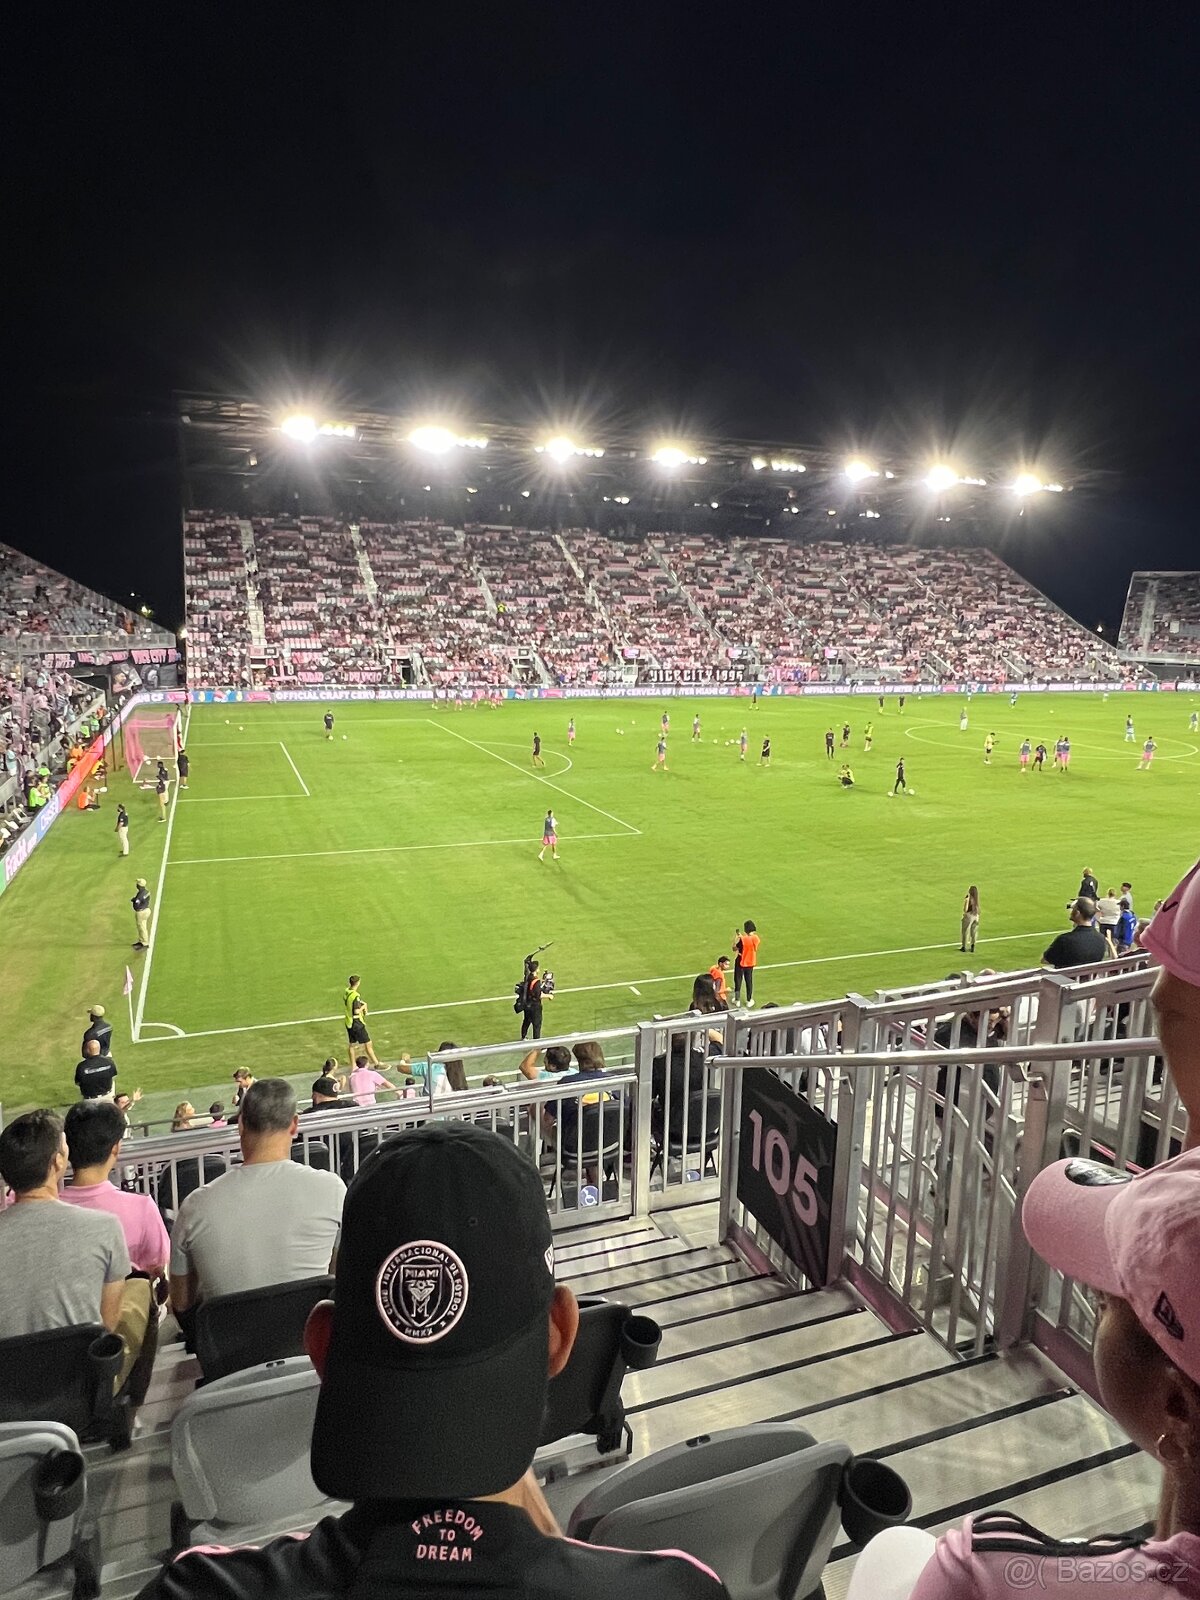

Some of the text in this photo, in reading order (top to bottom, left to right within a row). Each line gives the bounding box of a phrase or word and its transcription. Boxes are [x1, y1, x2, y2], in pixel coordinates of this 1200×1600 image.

[649, 669, 681, 682] VICE
[683, 669, 713, 682] CITY
[275, 690, 319, 700] OFFICIAL
[319, 690, 350, 699] CRAFT
[351, 690, 393, 699] CERVZA
[393, 690, 406, 699] OF
[406, 690, 433, 699] INTER
[565, 688, 600, 697] OFFICIAL
[626, 688, 661, 696] CERVEZA
[804, 686, 834, 694] OFFICIAL
[748, 1108, 818, 1227] 105
[382, 1246, 450, 1285] INTERNACIONAL
[449, 1262, 459, 1276] DE
[404, 1268, 439, 1278] MIAMI
[381, 1289, 393, 1315] CLUB
[404, 1327, 433, 1337] MMXX
[411, 1508, 484, 1542] FREEDOM
[439, 1528, 456, 1542] TO
[416, 1544, 472, 1562] DREAM
